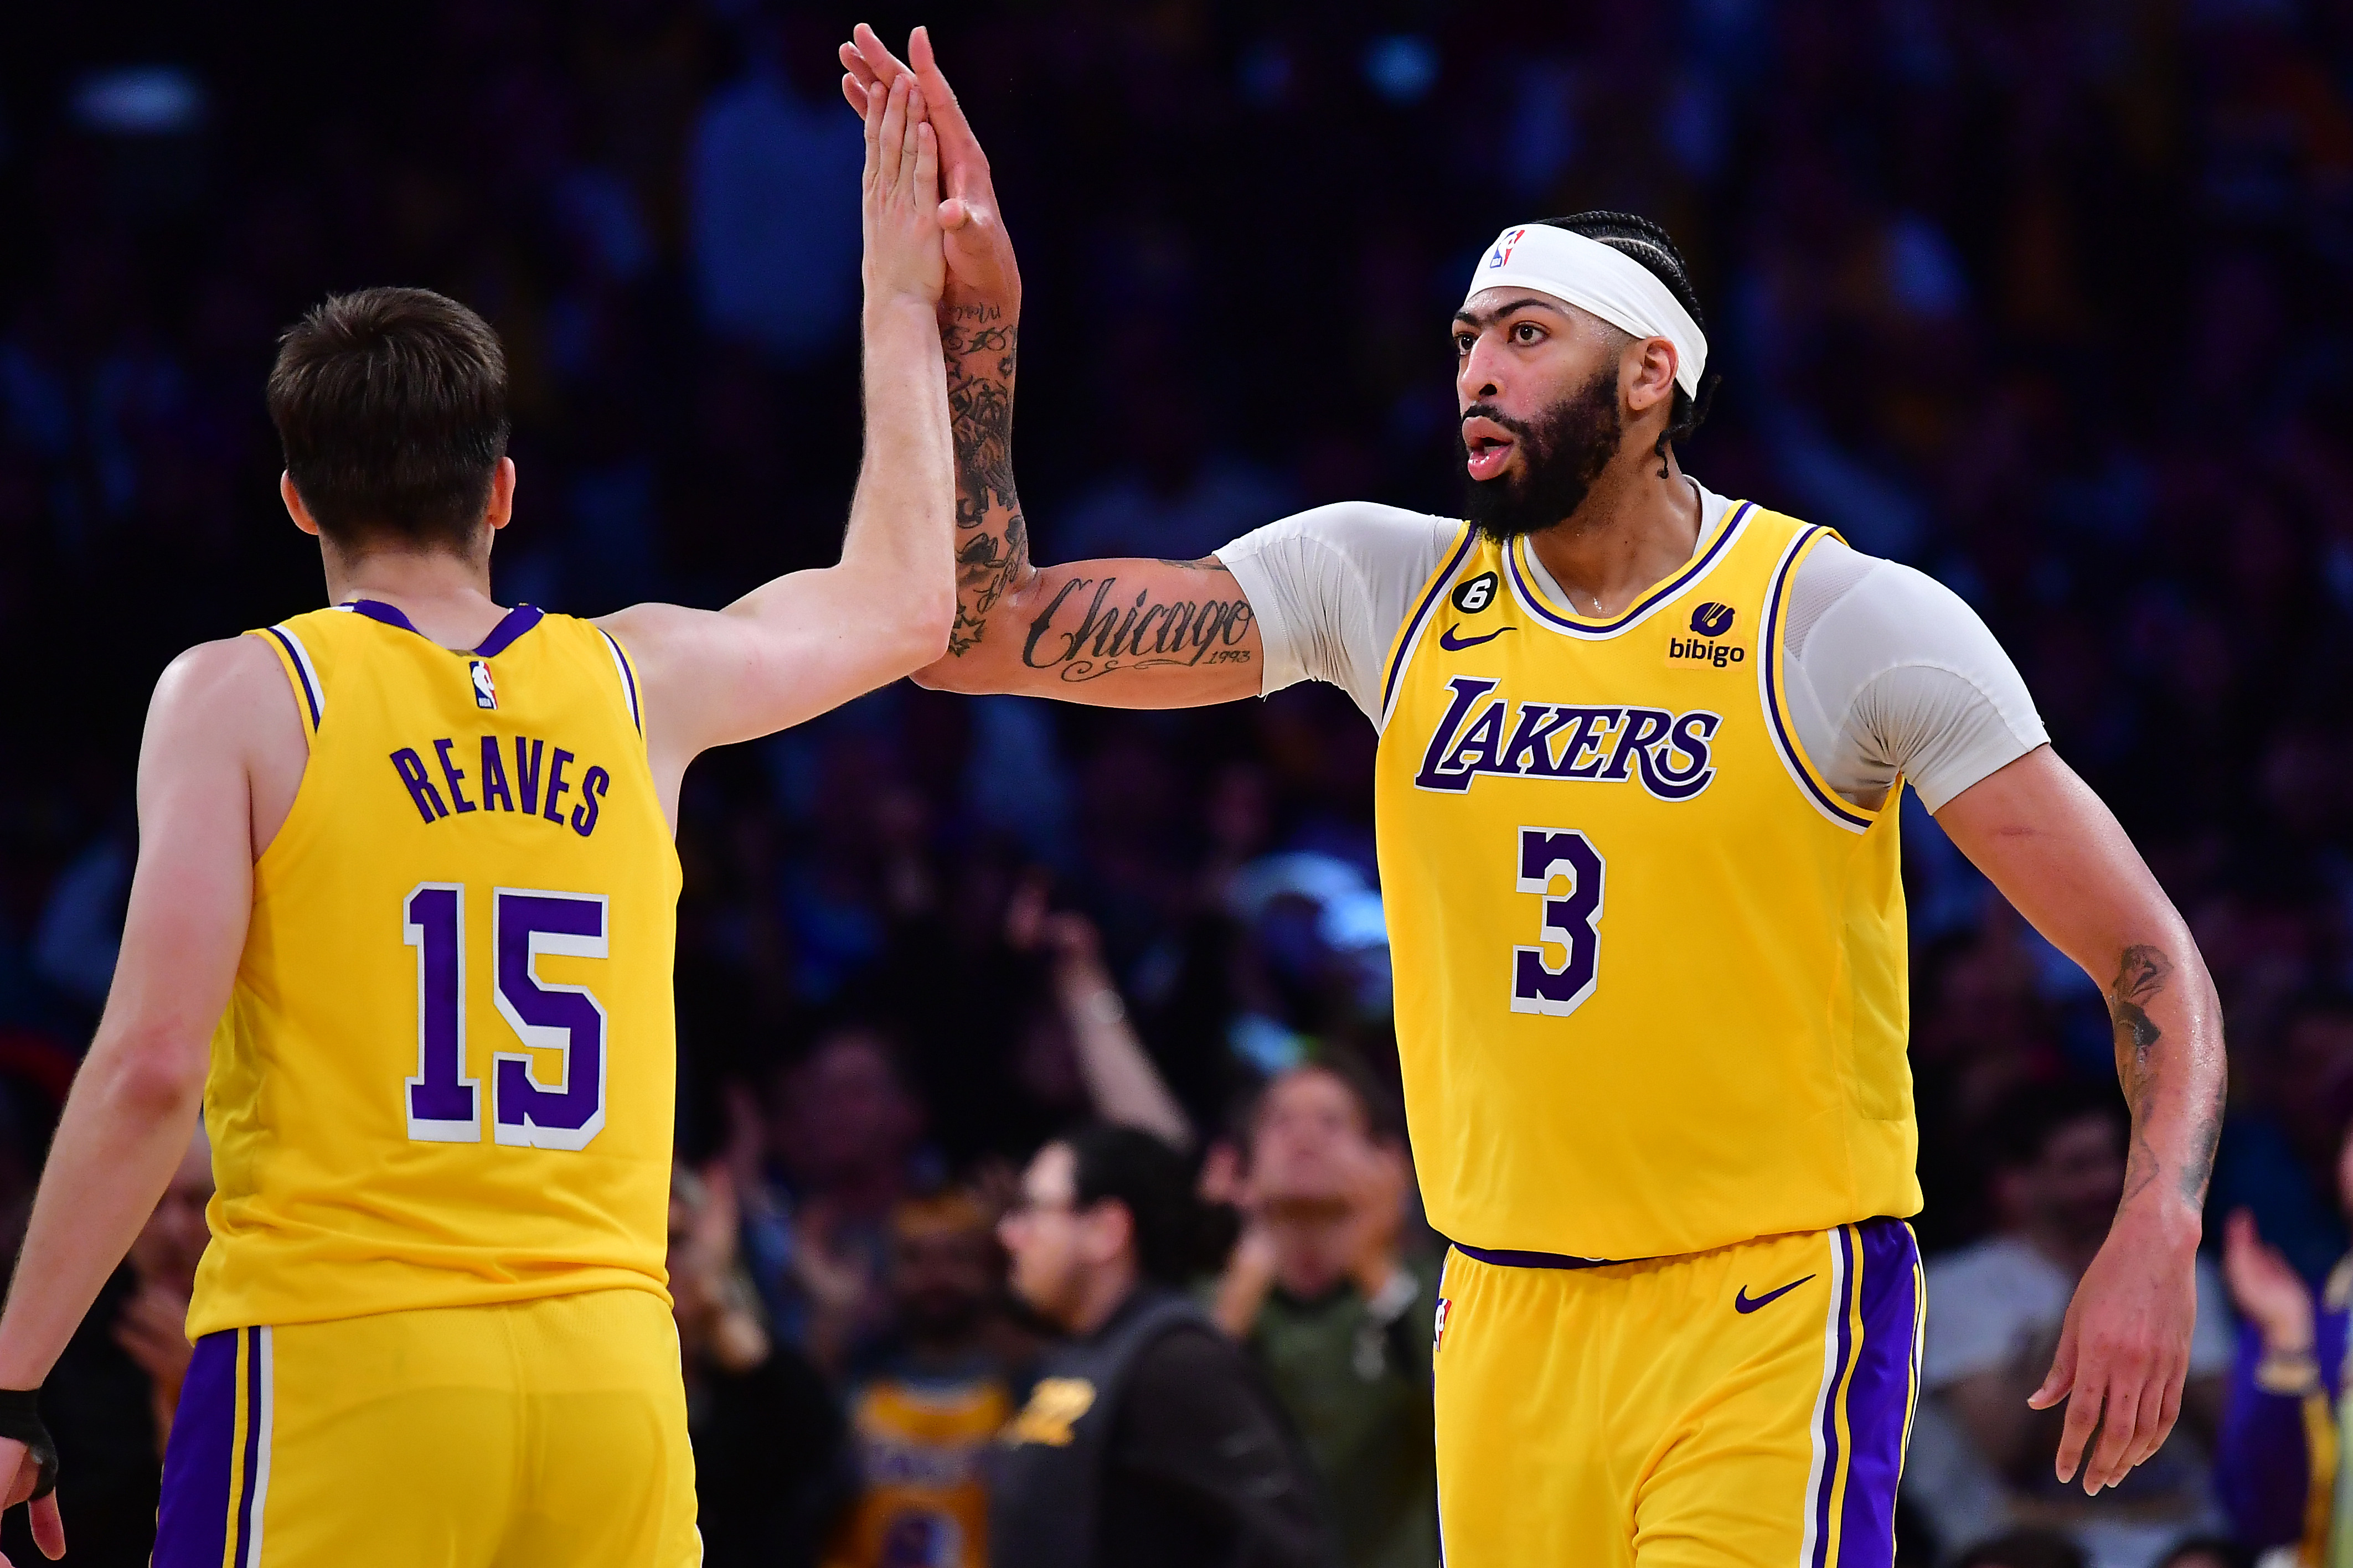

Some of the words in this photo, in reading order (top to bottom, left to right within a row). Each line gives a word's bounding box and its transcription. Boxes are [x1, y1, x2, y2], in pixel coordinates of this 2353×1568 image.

[1023, 577, 1254, 668] Chicago
[1461, 577, 1492, 609] 6
[1202, 650, 1250, 664] 1993
[1669, 637, 1745, 668] bibigo
[1414, 674, 1724, 801] LAKERS
[389, 736, 610, 837] REAVES
[1510, 825, 1607, 1017] 3
[403, 881, 609, 1151] 15
